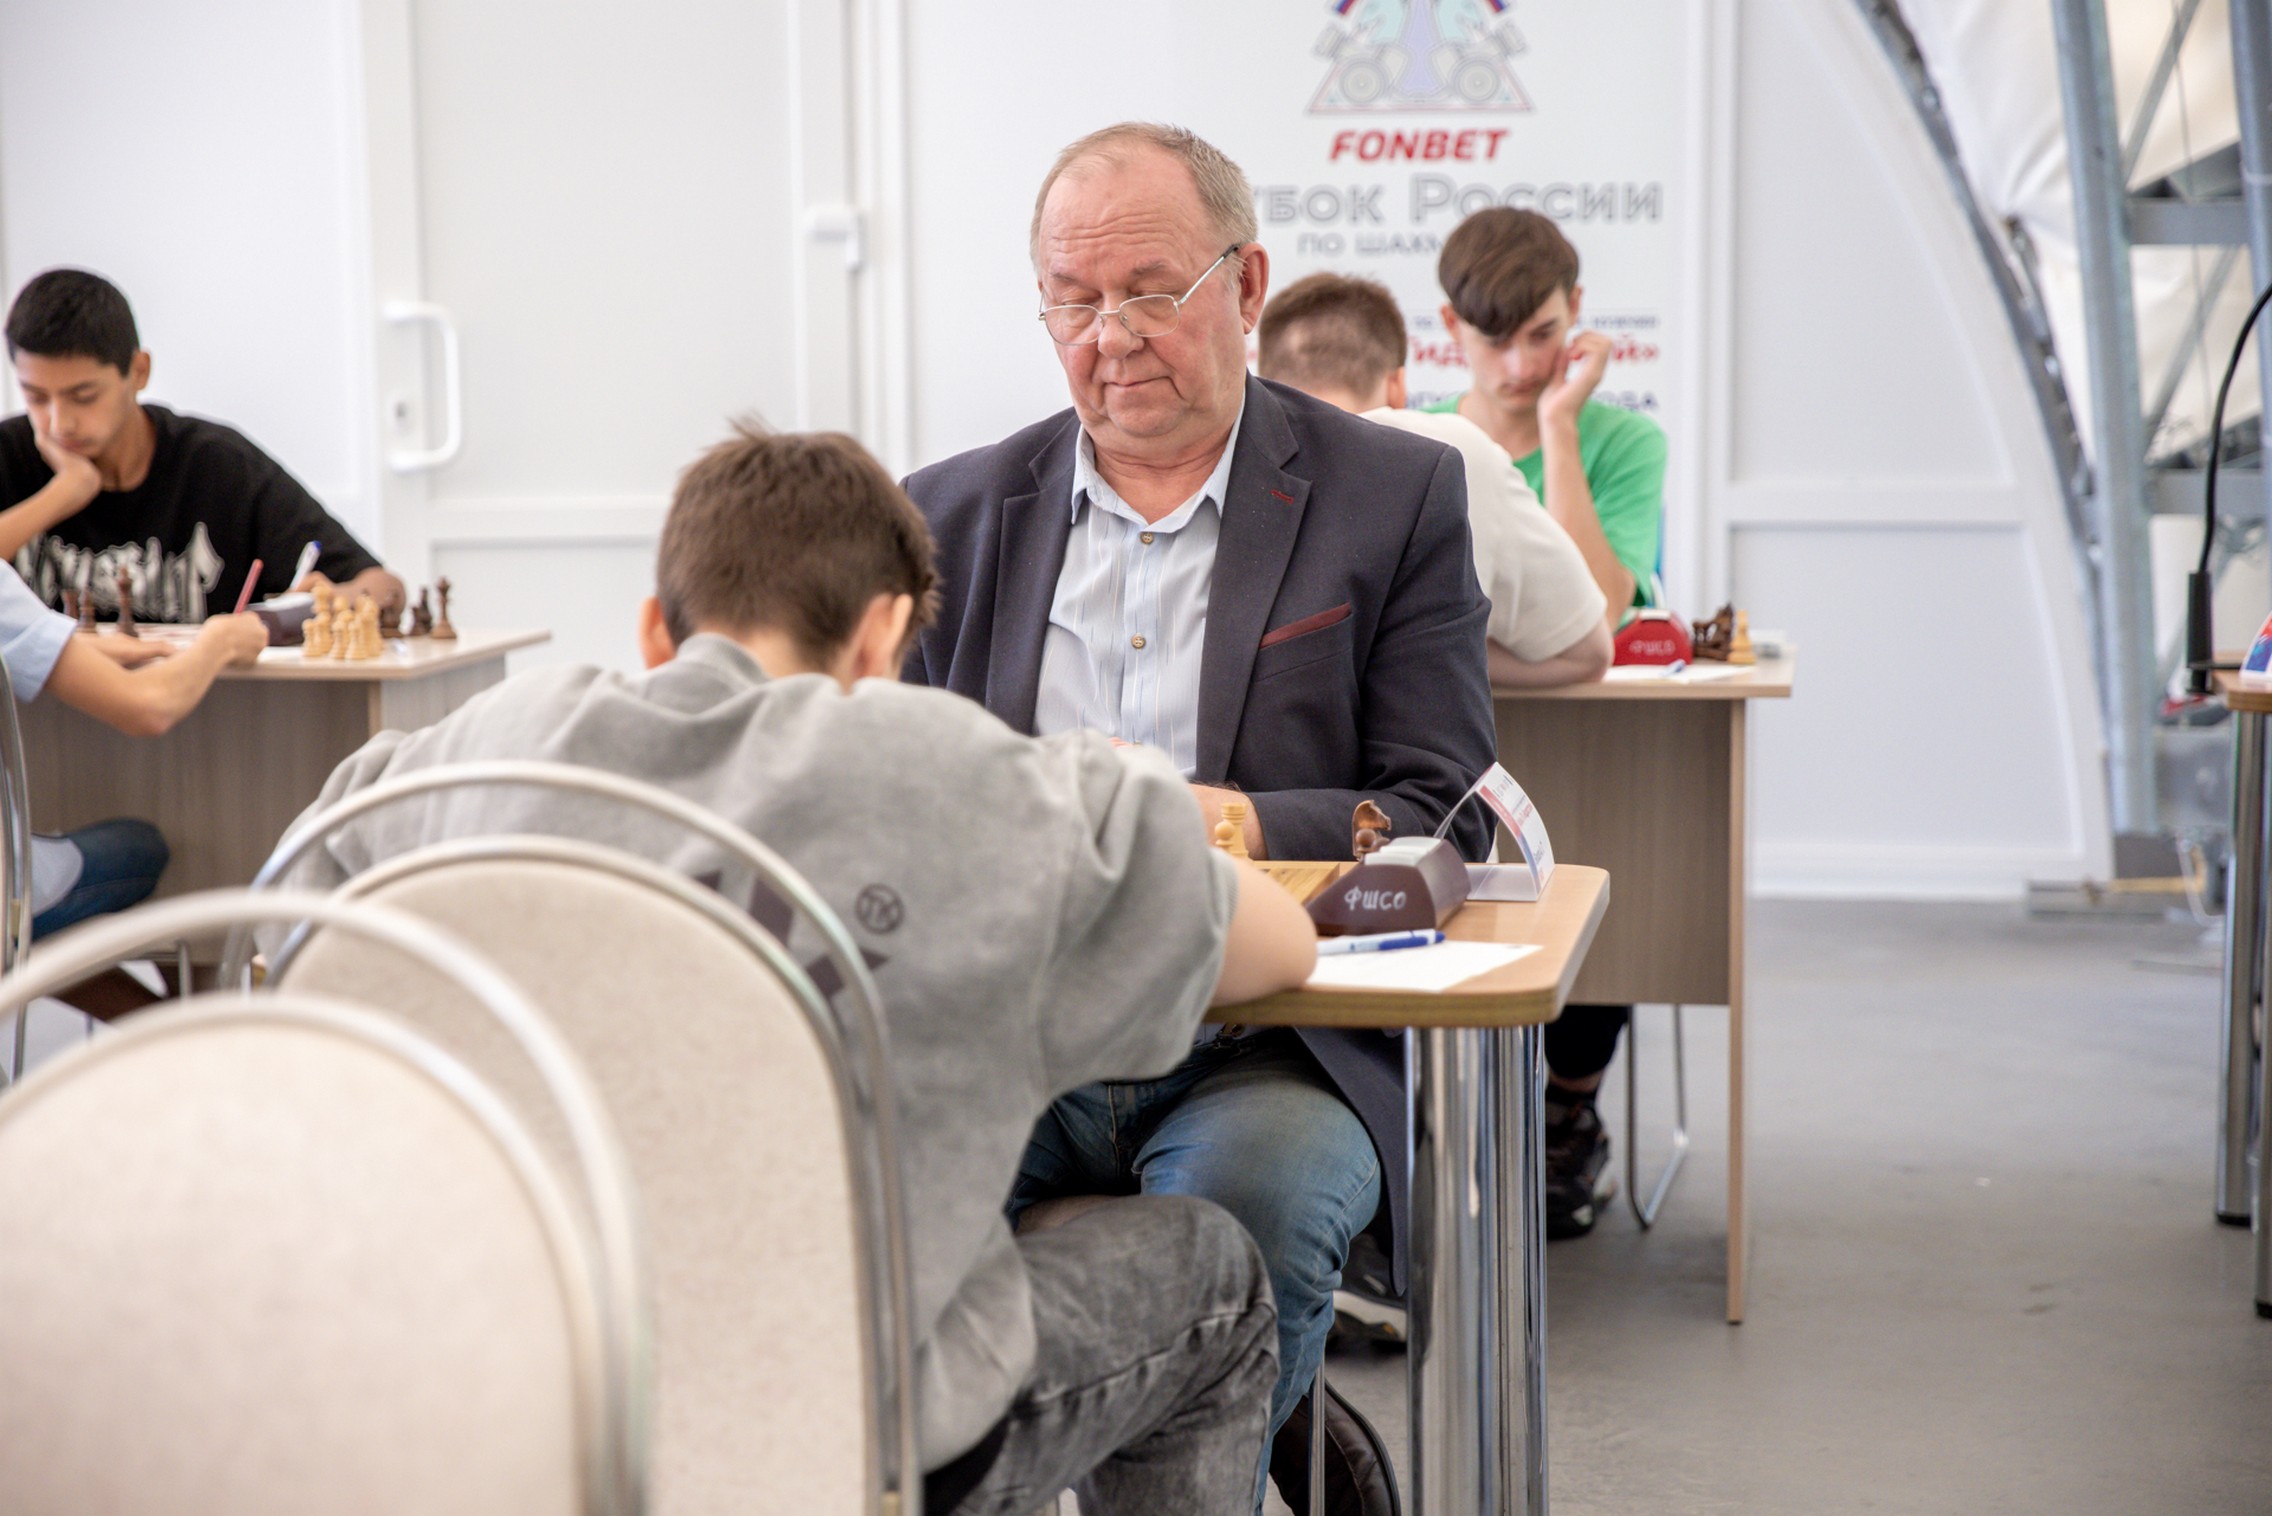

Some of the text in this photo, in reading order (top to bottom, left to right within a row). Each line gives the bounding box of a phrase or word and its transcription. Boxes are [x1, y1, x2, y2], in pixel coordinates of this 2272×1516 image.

[1330, 129, 1509, 162] FONBET
[1253, 184, 1382, 222] БОК
[1344, 886, 1406, 911] ФШСО
